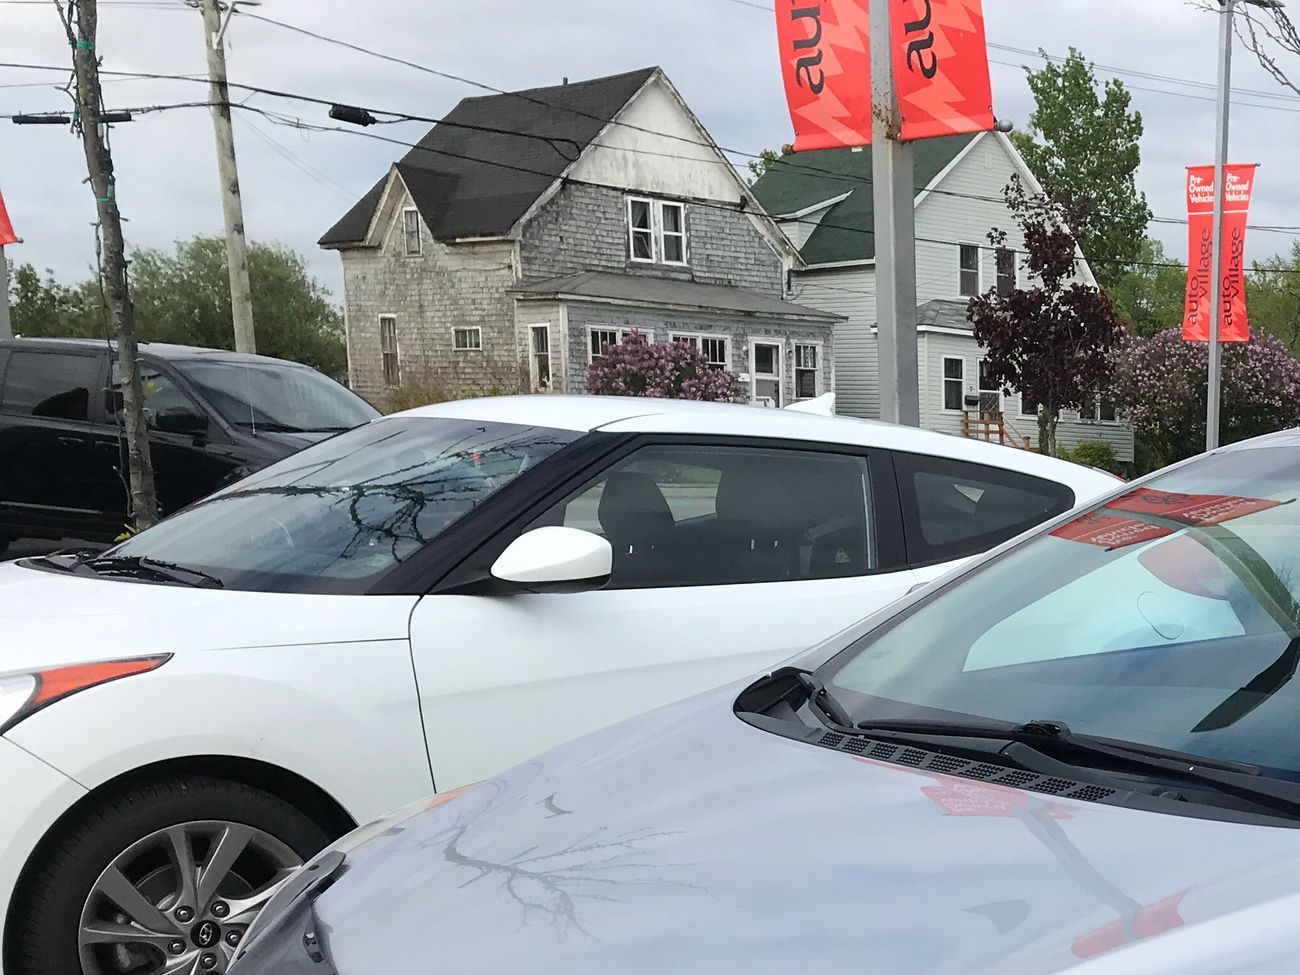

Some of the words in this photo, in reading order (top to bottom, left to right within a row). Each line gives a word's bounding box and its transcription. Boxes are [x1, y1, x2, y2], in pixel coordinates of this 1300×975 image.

[791, 0, 826, 95] au
[1189, 181, 1214, 193] Owned
[1190, 174, 1204, 184] Pre-
[1225, 180, 1249, 191] Owned
[1226, 172, 1240, 182] Pre-
[1197, 228, 1213, 299] village
[1228, 227, 1244, 299] village
[1188, 276, 1199, 326] auto
[1222, 276, 1232, 326] auto
